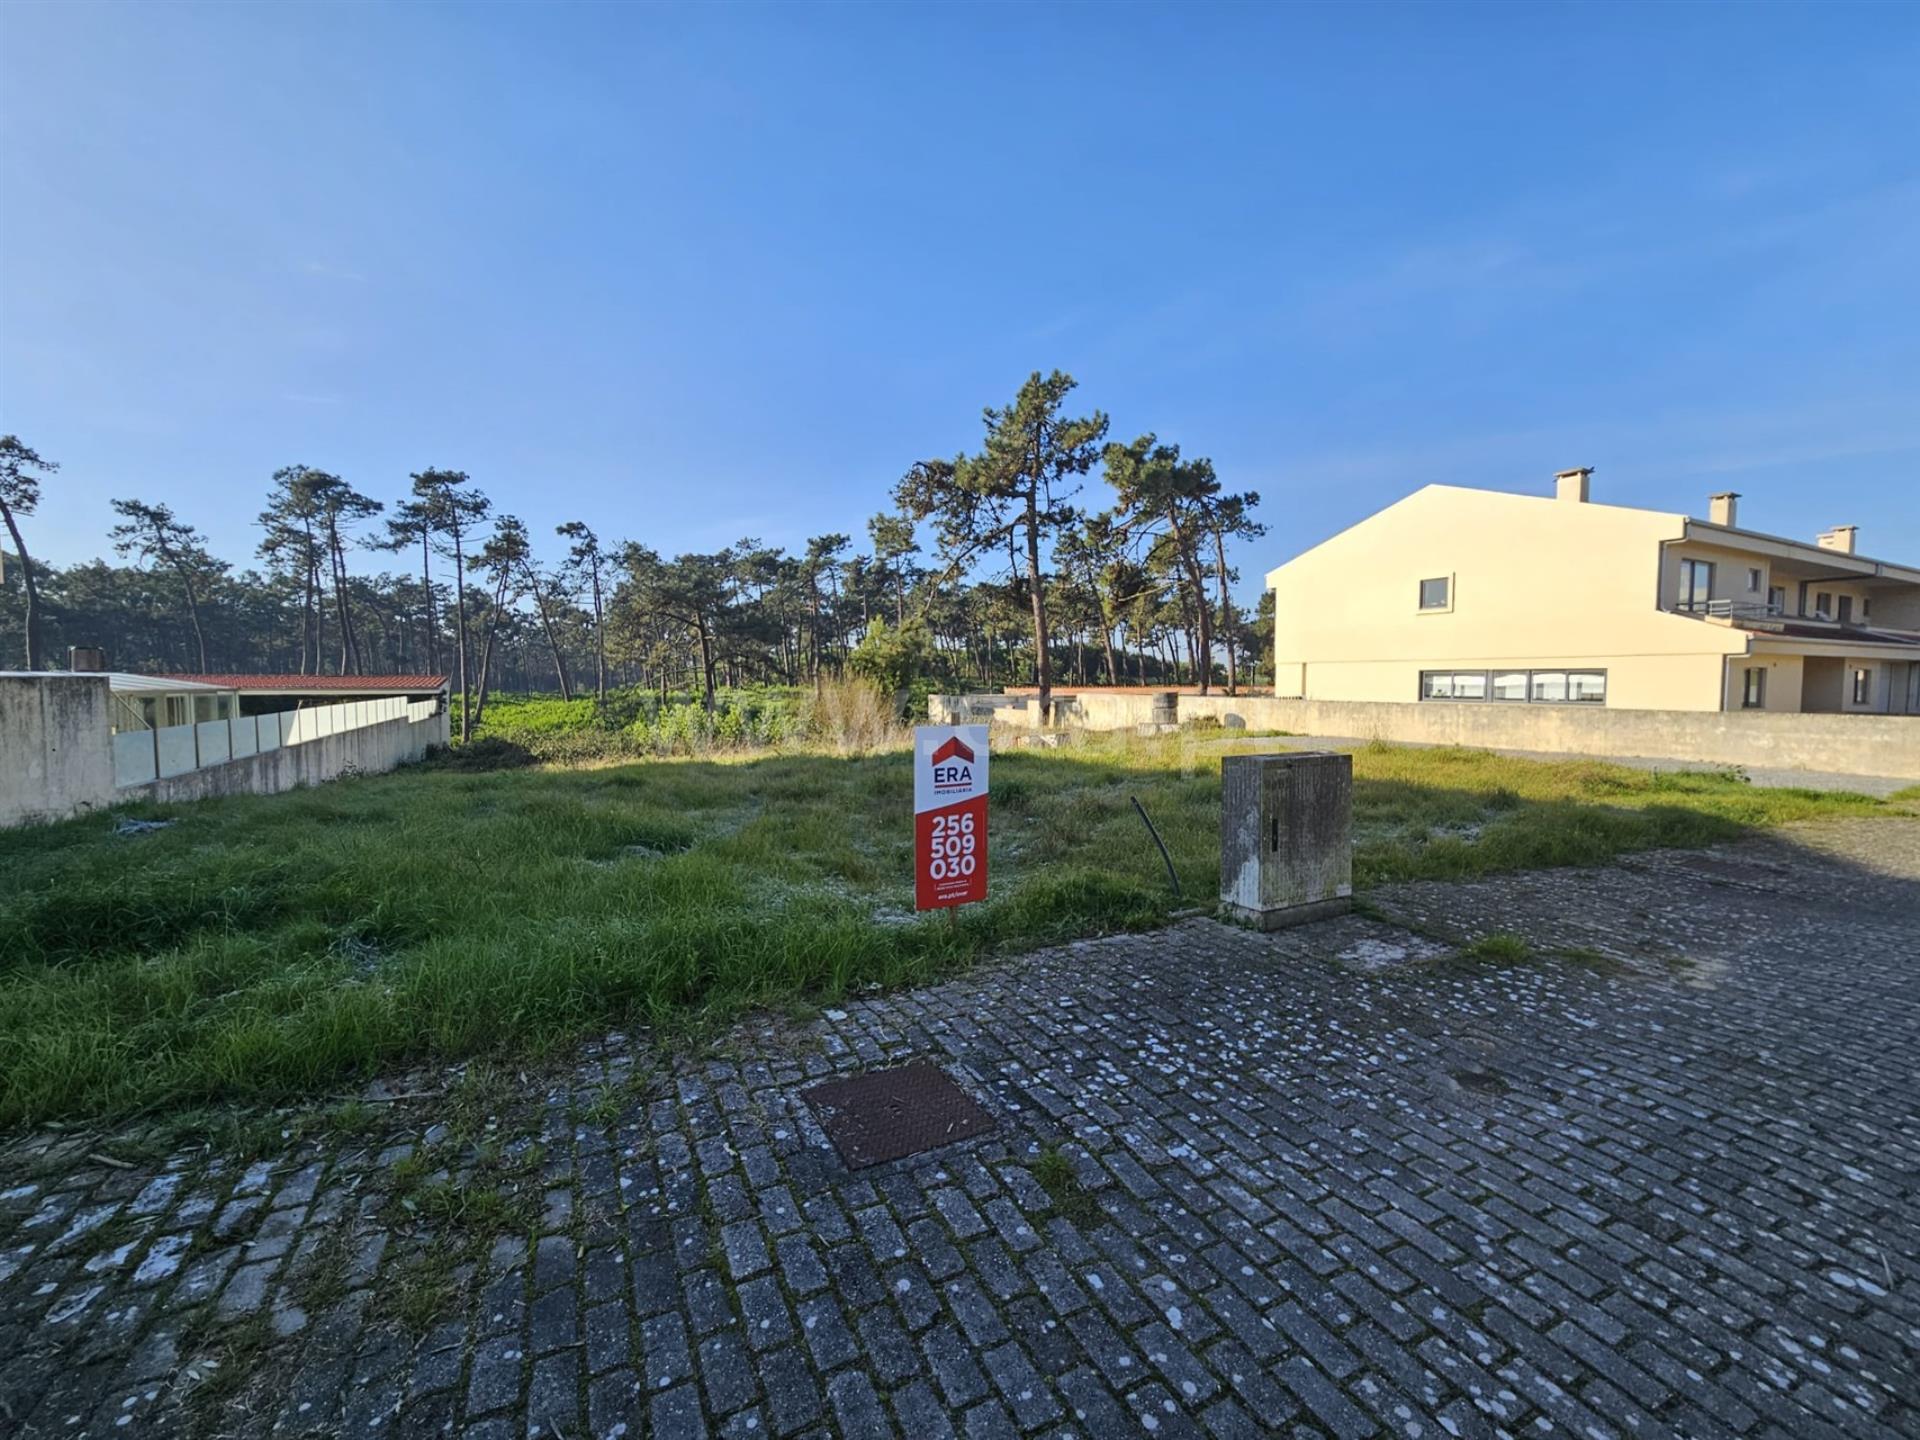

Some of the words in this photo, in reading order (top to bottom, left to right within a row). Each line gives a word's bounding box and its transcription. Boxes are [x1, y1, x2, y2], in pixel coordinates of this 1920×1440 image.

[934, 766, 972, 783] ERA
[932, 812, 974, 838] 256
[930, 834, 976, 859] 509
[929, 855, 976, 881] 030
